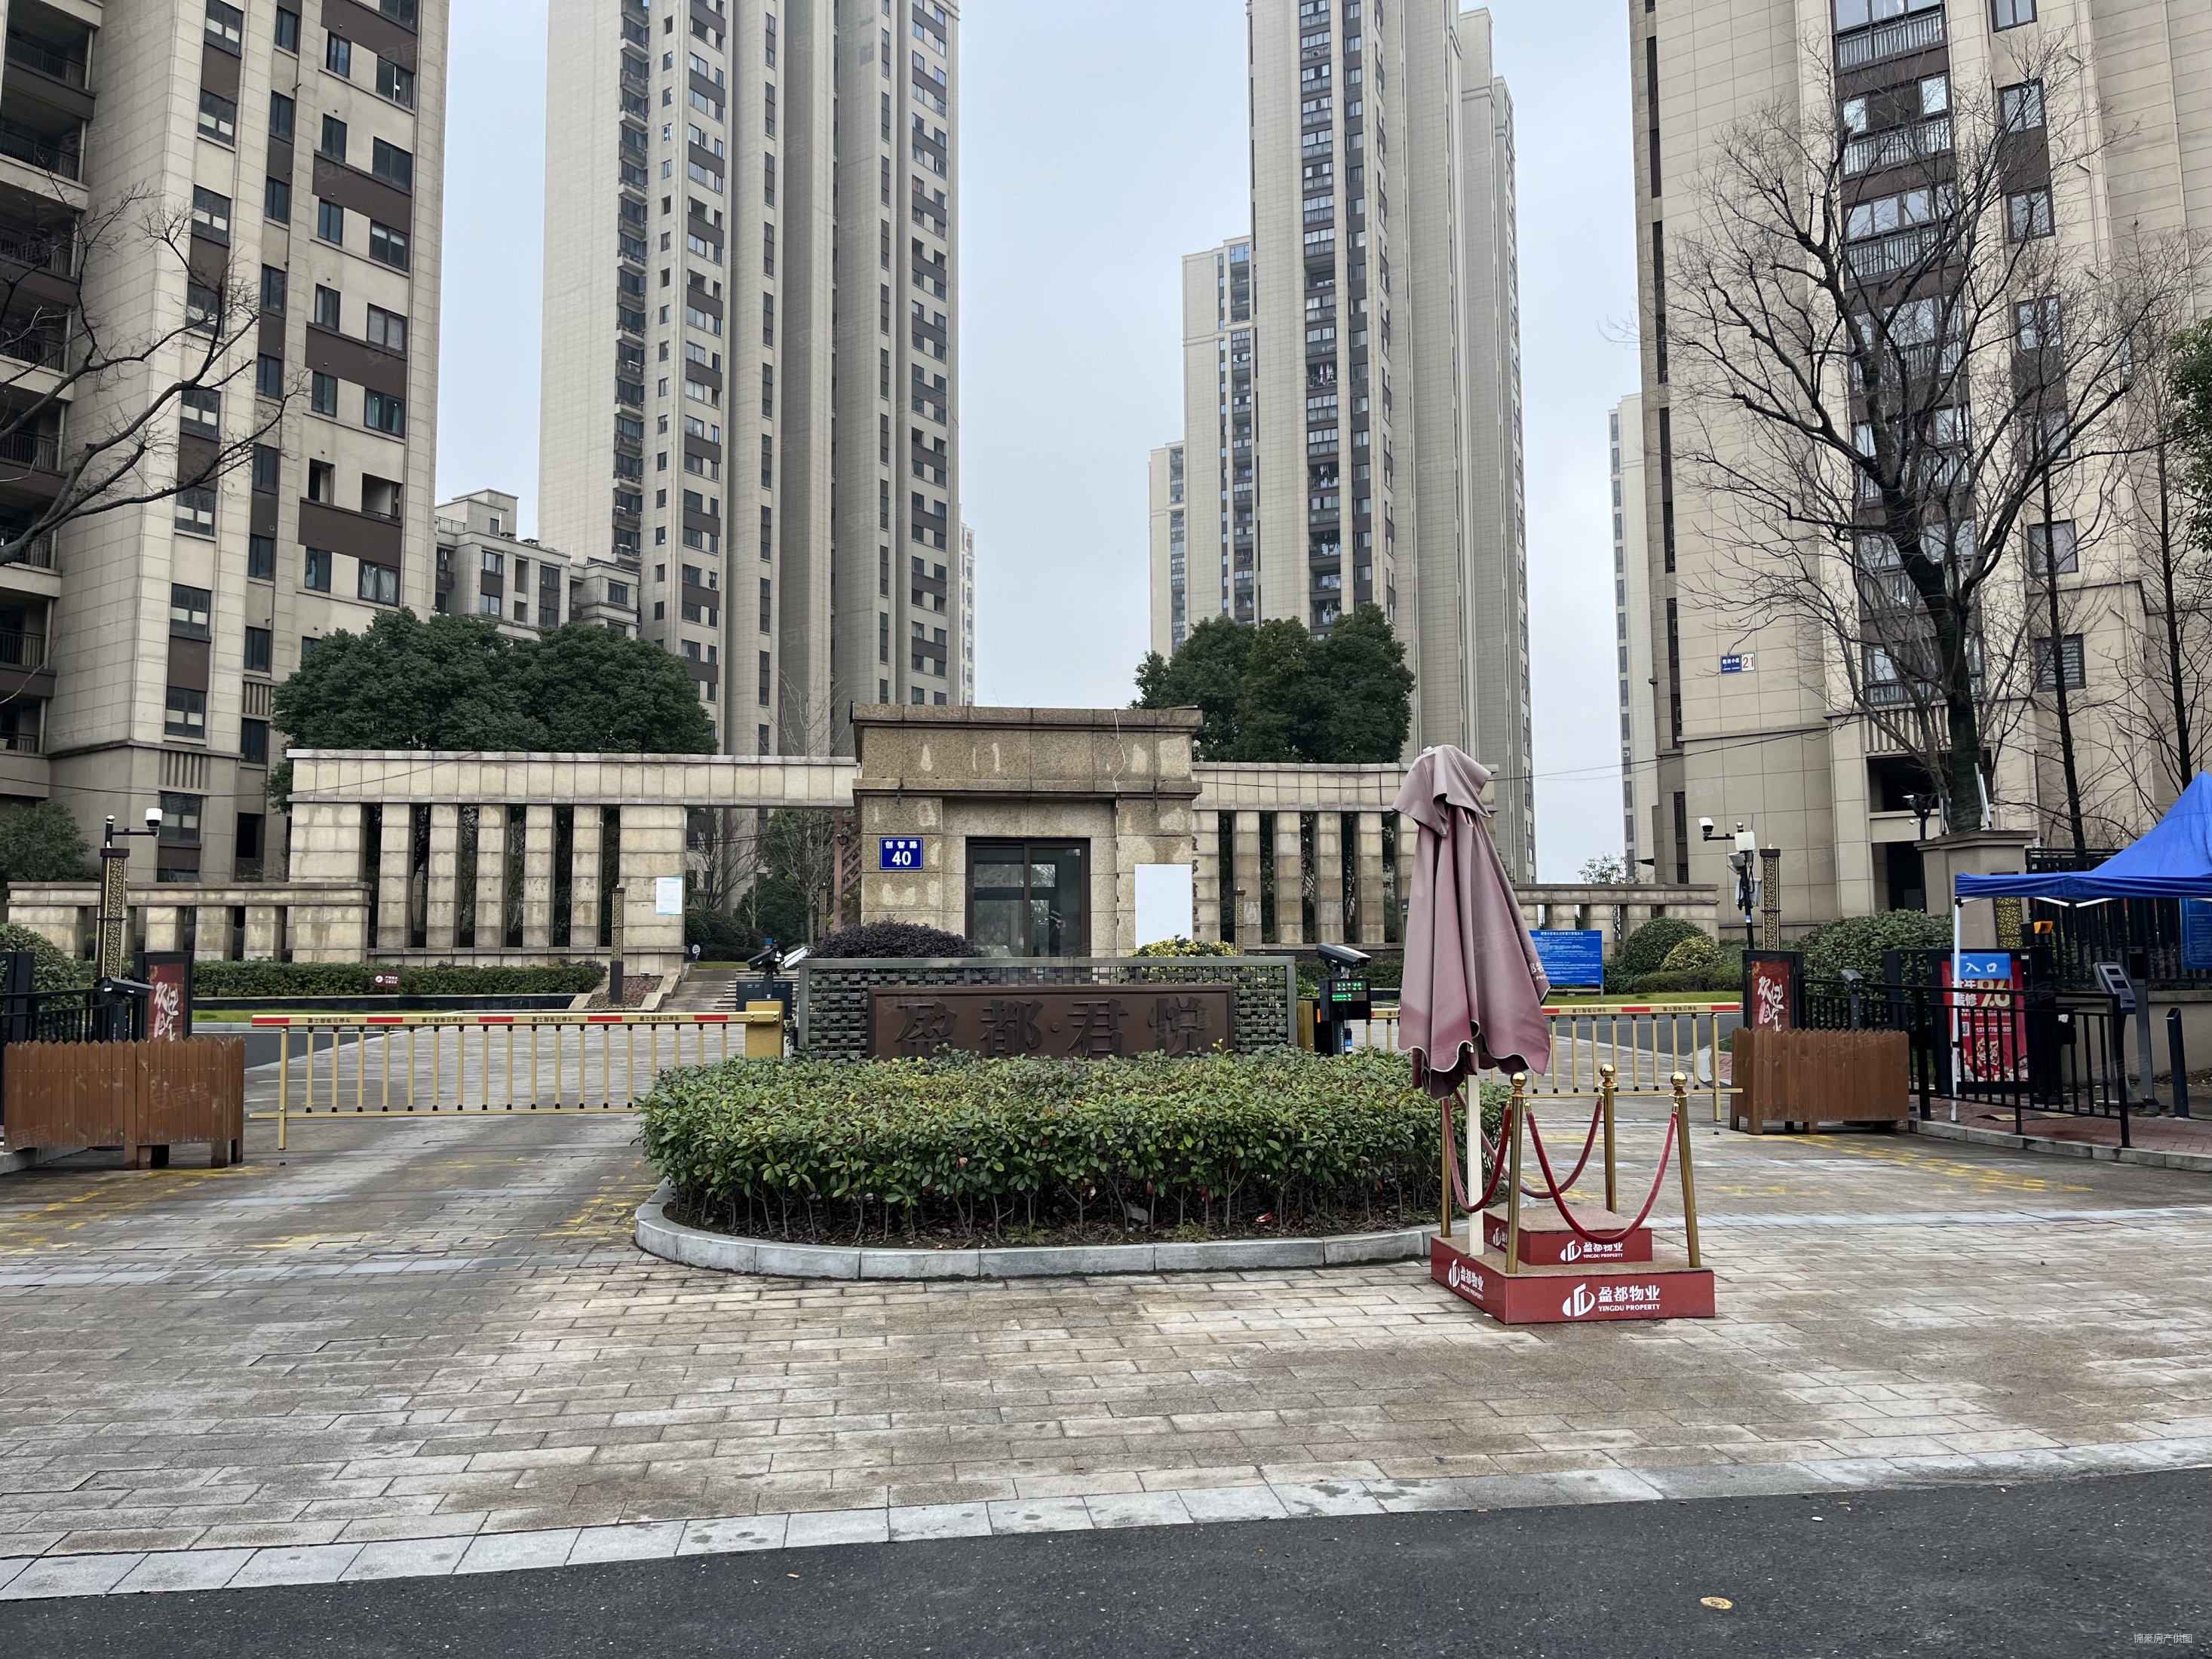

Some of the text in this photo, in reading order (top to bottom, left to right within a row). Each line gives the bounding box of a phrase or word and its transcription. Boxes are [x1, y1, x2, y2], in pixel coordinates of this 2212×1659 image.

[1743, 656, 1754, 668] 21
[892, 851, 911, 866] 40
[1965, 962, 1997, 973] 入口
[1583, 1241, 1623, 1253] 盈都物业
[1460, 1265, 1483, 1292] 盈都物业
[1598, 1285, 1661, 1303] 盈都物业
